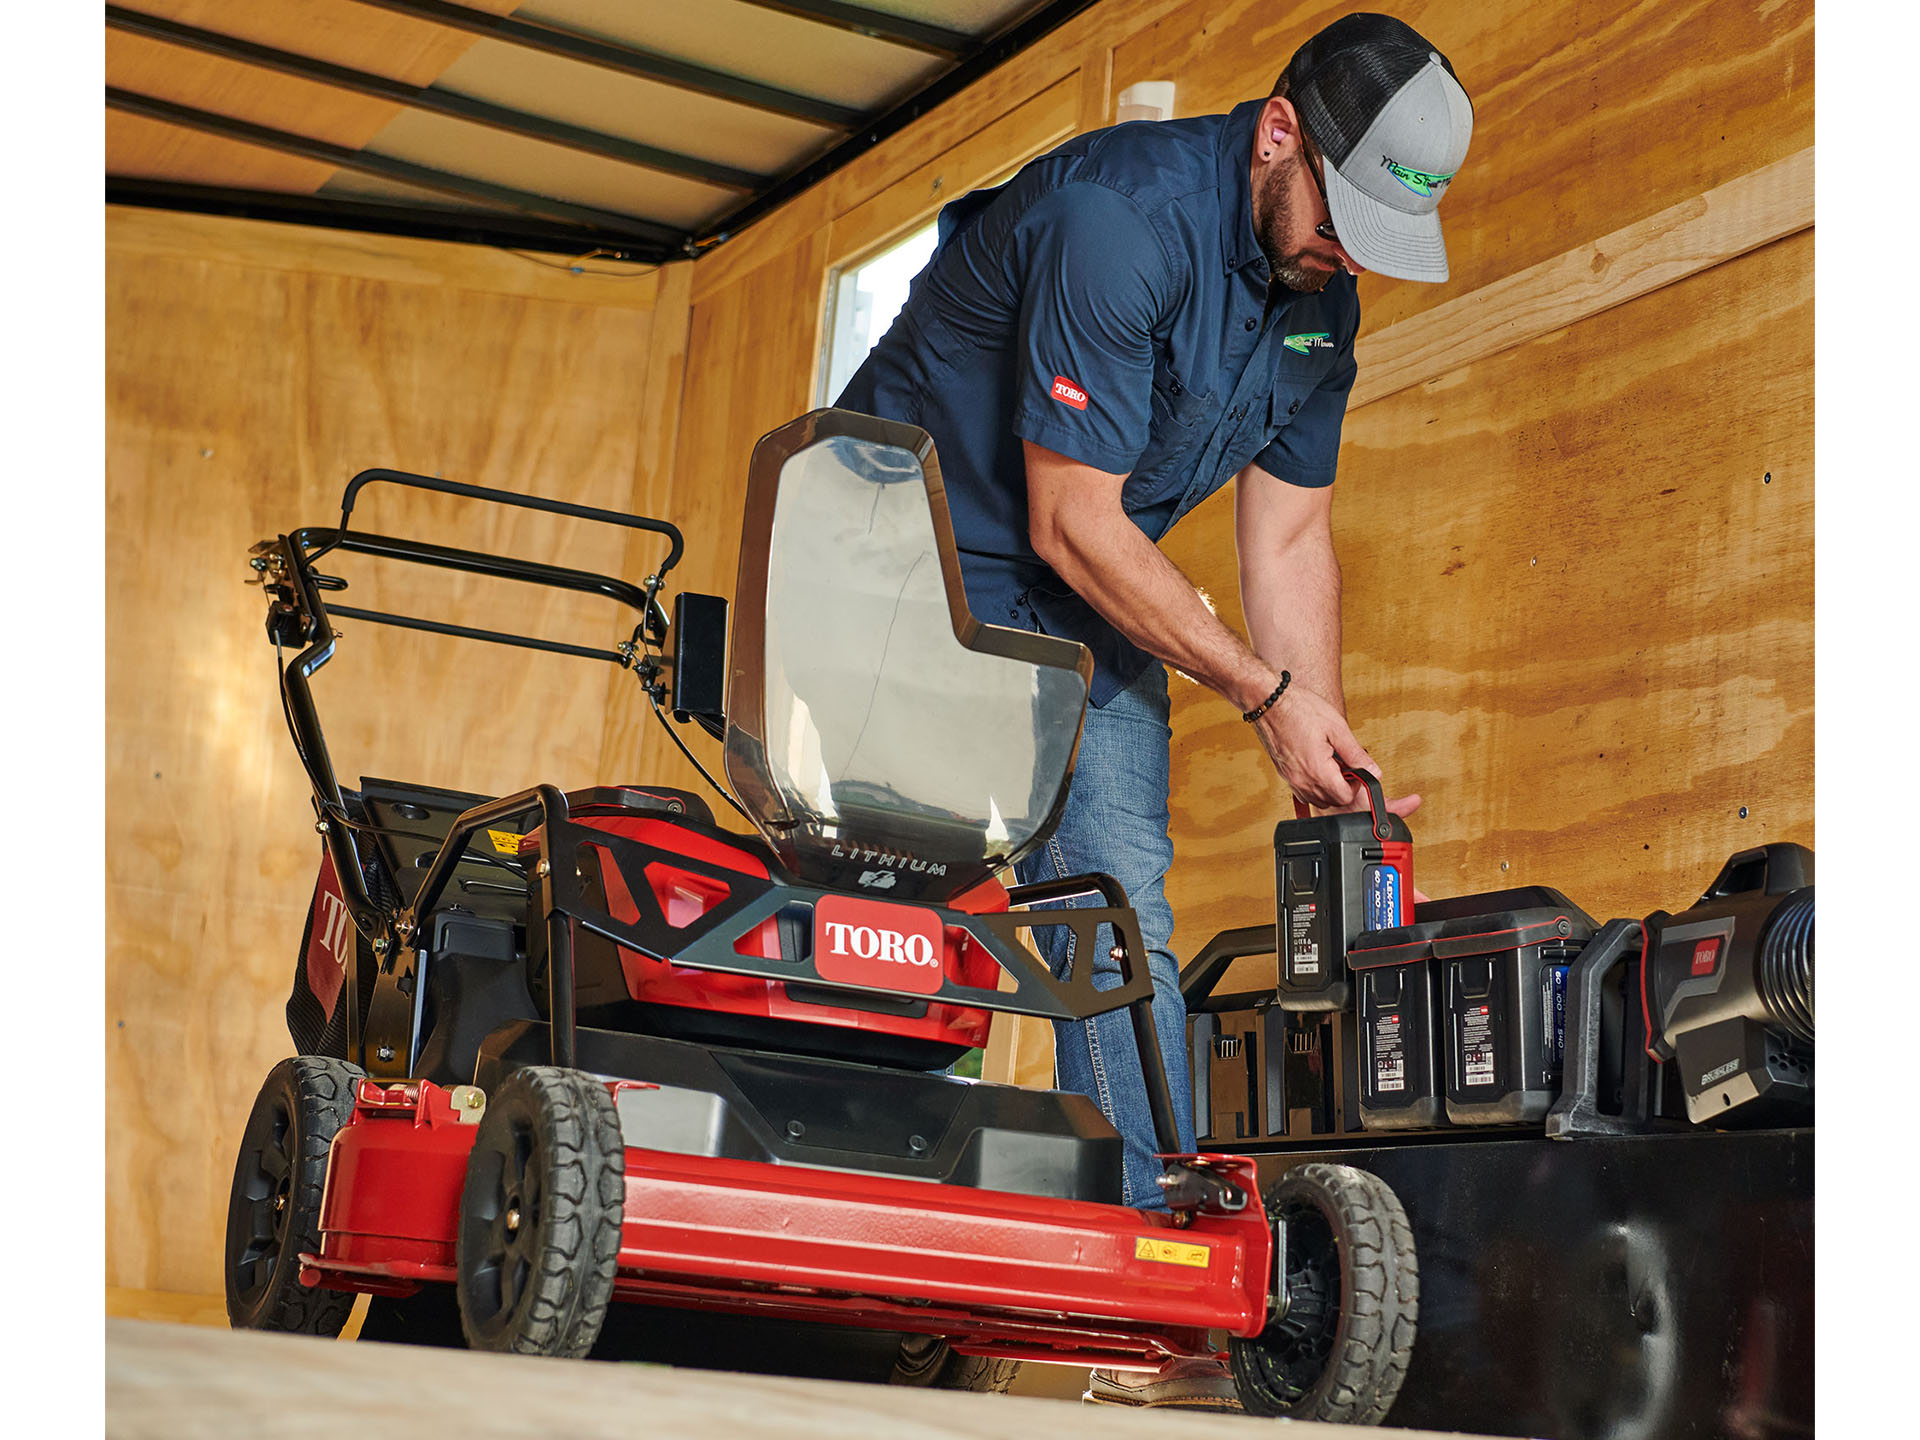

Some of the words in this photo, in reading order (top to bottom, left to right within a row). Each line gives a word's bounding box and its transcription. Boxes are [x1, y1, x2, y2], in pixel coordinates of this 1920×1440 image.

[1380, 155, 1409, 180] Main
[1055, 383, 1086, 402] TORO
[832, 845, 947, 876] LITHIUM
[1386, 873, 1394, 929] FLEX-FORC
[320, 890, 348, 976] TO
[826, 922, 934, 966] TORO
[1695, 949, 1715, 964] TORO
